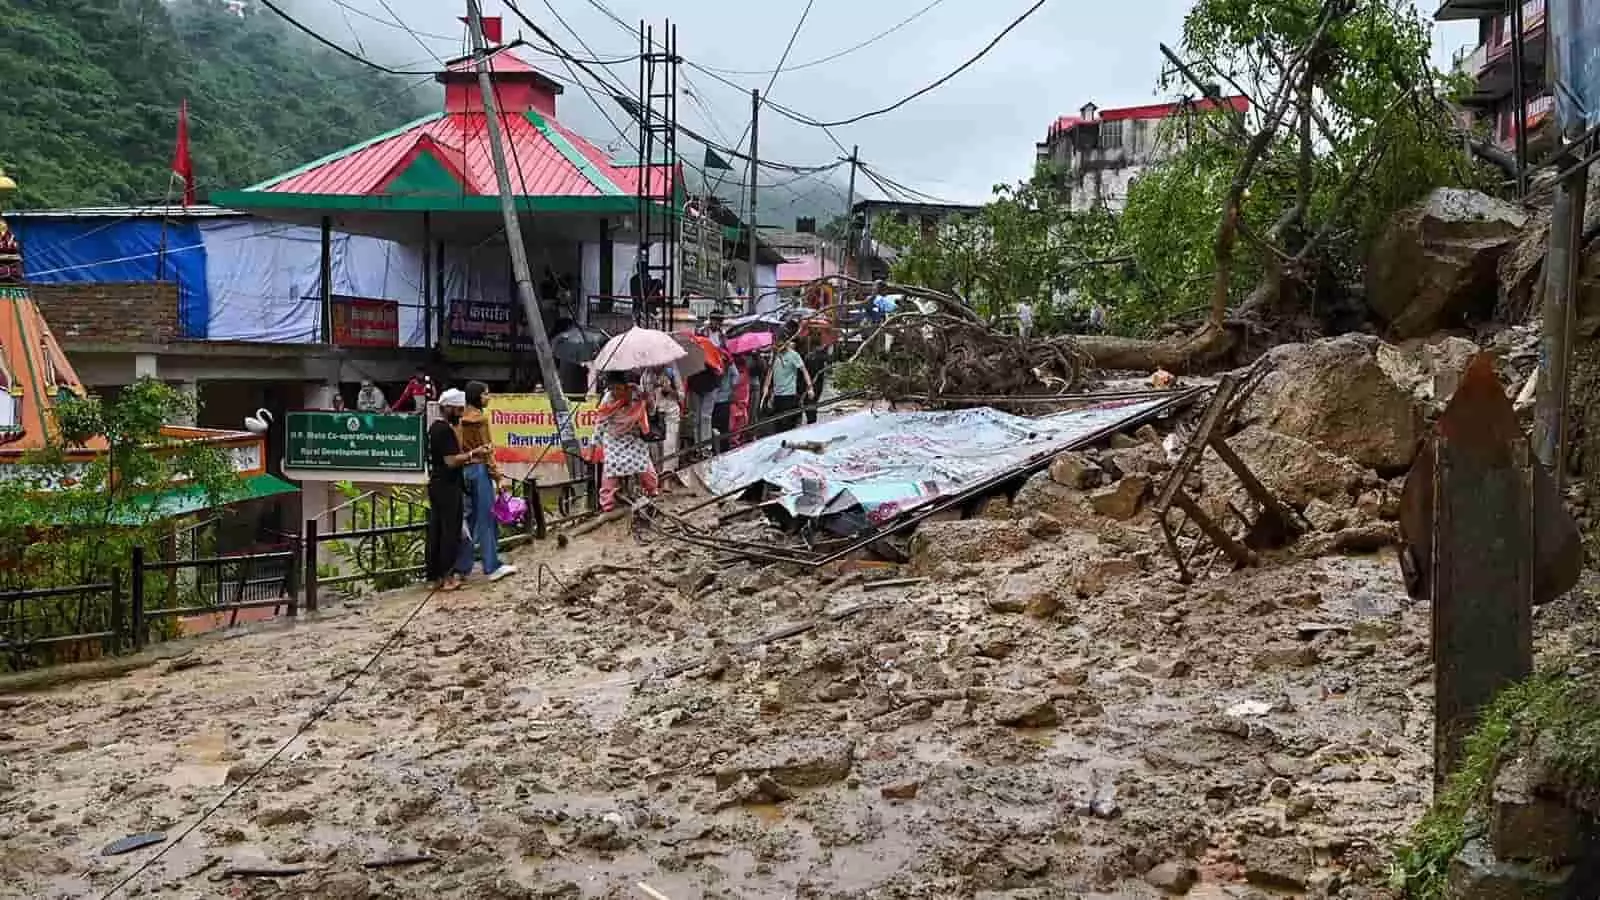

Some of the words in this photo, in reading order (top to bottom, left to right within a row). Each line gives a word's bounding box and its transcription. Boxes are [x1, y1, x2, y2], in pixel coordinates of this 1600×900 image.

[491, 409, 545, 425] विश्वकर्मा
[328, 432, 374, 442] Co-operative
[376, 433, 417, 443] Agriculture
[507, 432, 533, 447] जिला
[300, 448, 320, 456] Rural
[321, 448, 370, 457] Development
[371, 449, 390, 457] Bank
[391, 448, 406, 457] Ltd.
